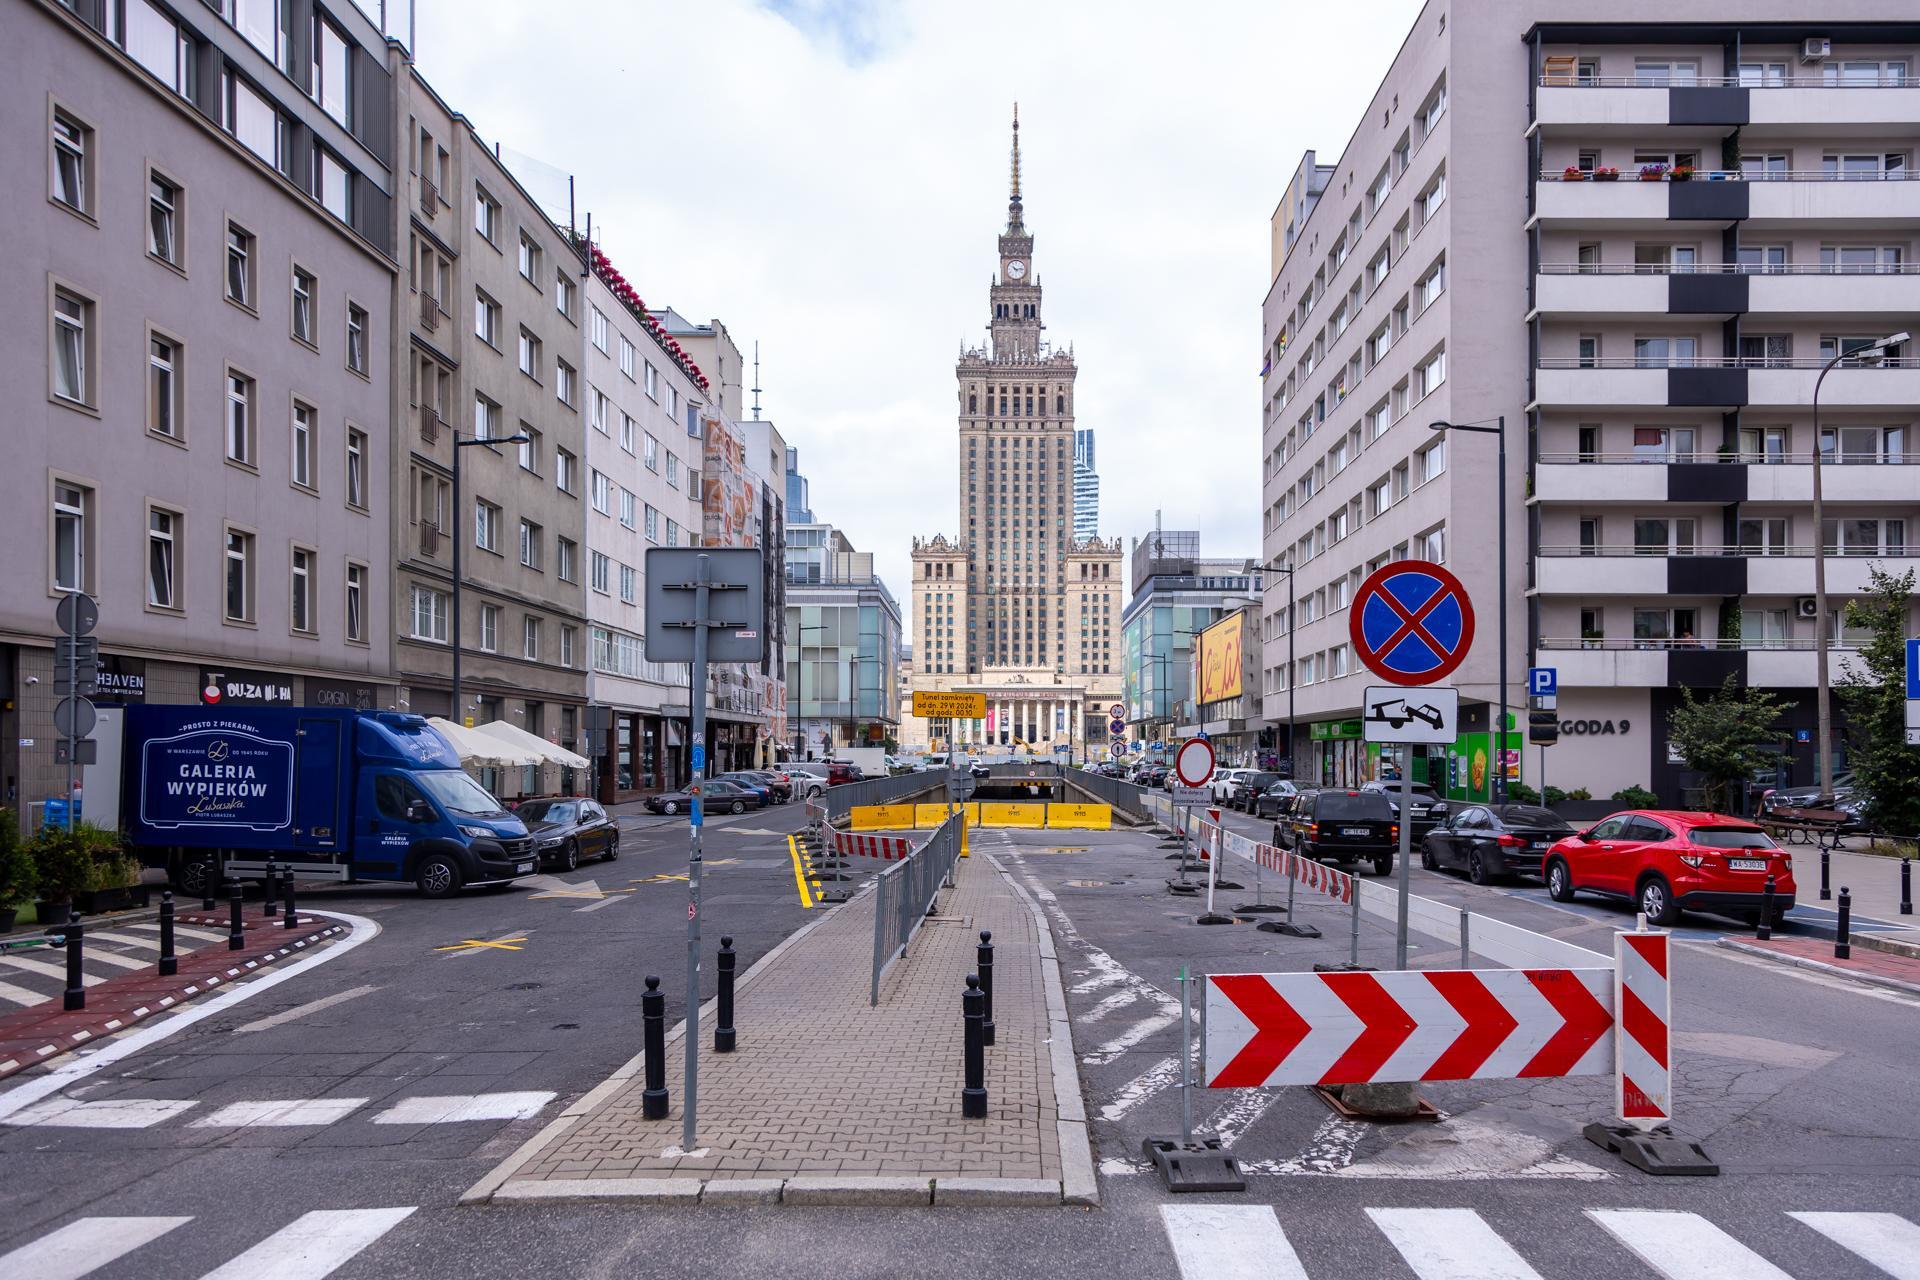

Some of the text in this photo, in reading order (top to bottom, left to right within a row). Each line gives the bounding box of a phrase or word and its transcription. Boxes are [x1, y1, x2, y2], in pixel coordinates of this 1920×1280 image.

[1535, 671, 1552, 692] P
[317, 689, 350, 705] ORIGIN
[941, 694, 975, 702] zamknięty
[936, 709, 955, 717] godz.
[183, 721, 211, 731] PROSTO
[220, 720, 256, 733] PIEKARNI
[1556, 719, 1631, 736] GODA 9
[1801, 733, 1807, 741] 9
[180, 764, 256, 779] GALERIA
[167, 780, 267, 797] WYPIEKÓW
